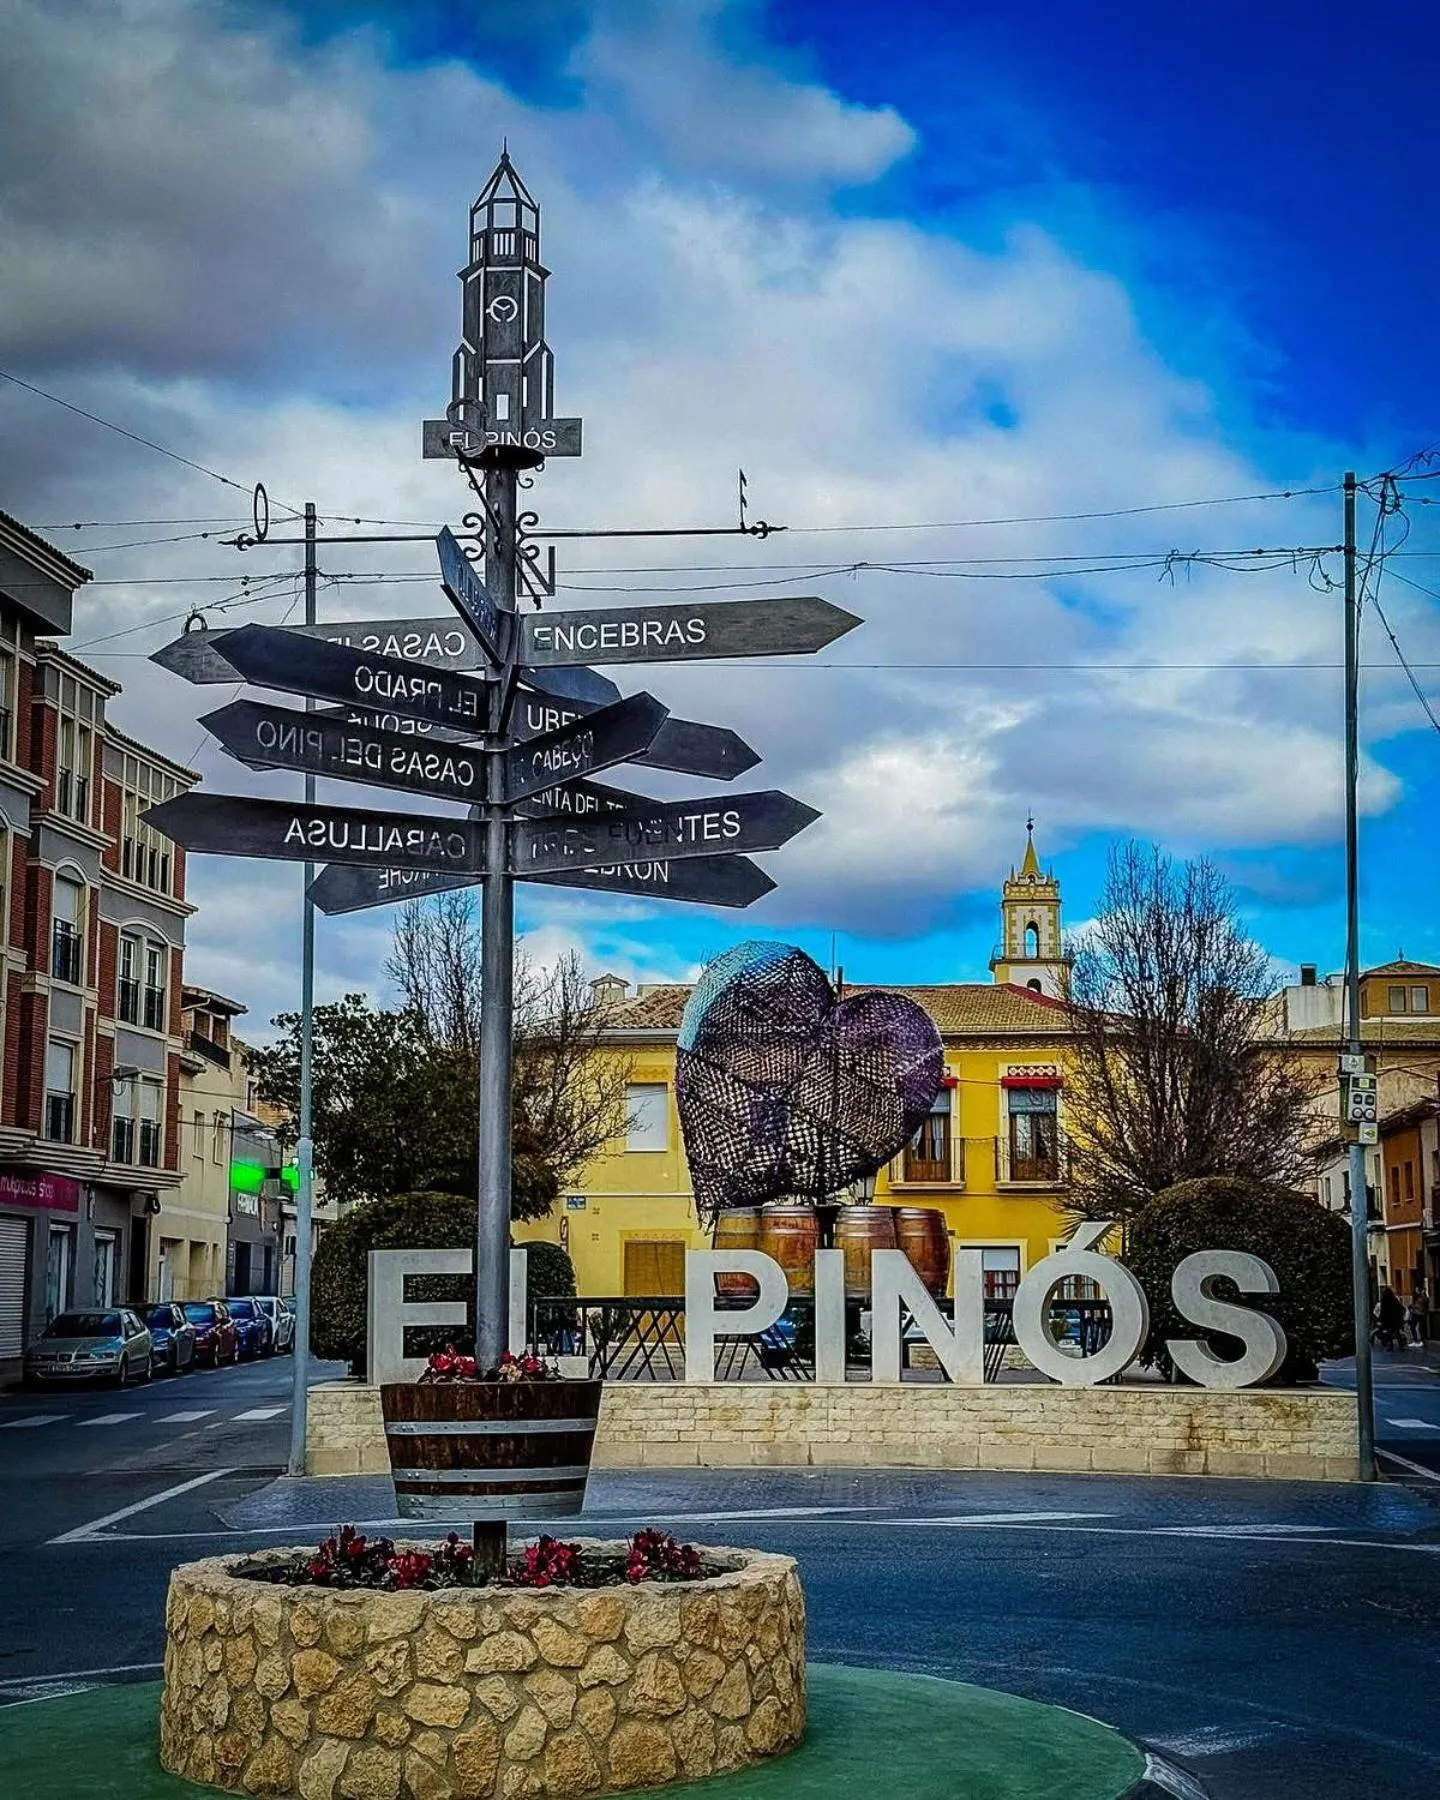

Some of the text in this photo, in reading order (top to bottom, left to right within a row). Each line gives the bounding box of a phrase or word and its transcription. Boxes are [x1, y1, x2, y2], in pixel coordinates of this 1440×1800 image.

[485, 427, 556, 449] PINÓS
[533, 618, 706, 651] ENCEBRAS
[609, 810, 741, 846] FUENTES
[368, 1222, 1288, 1389] EL PINÓS
